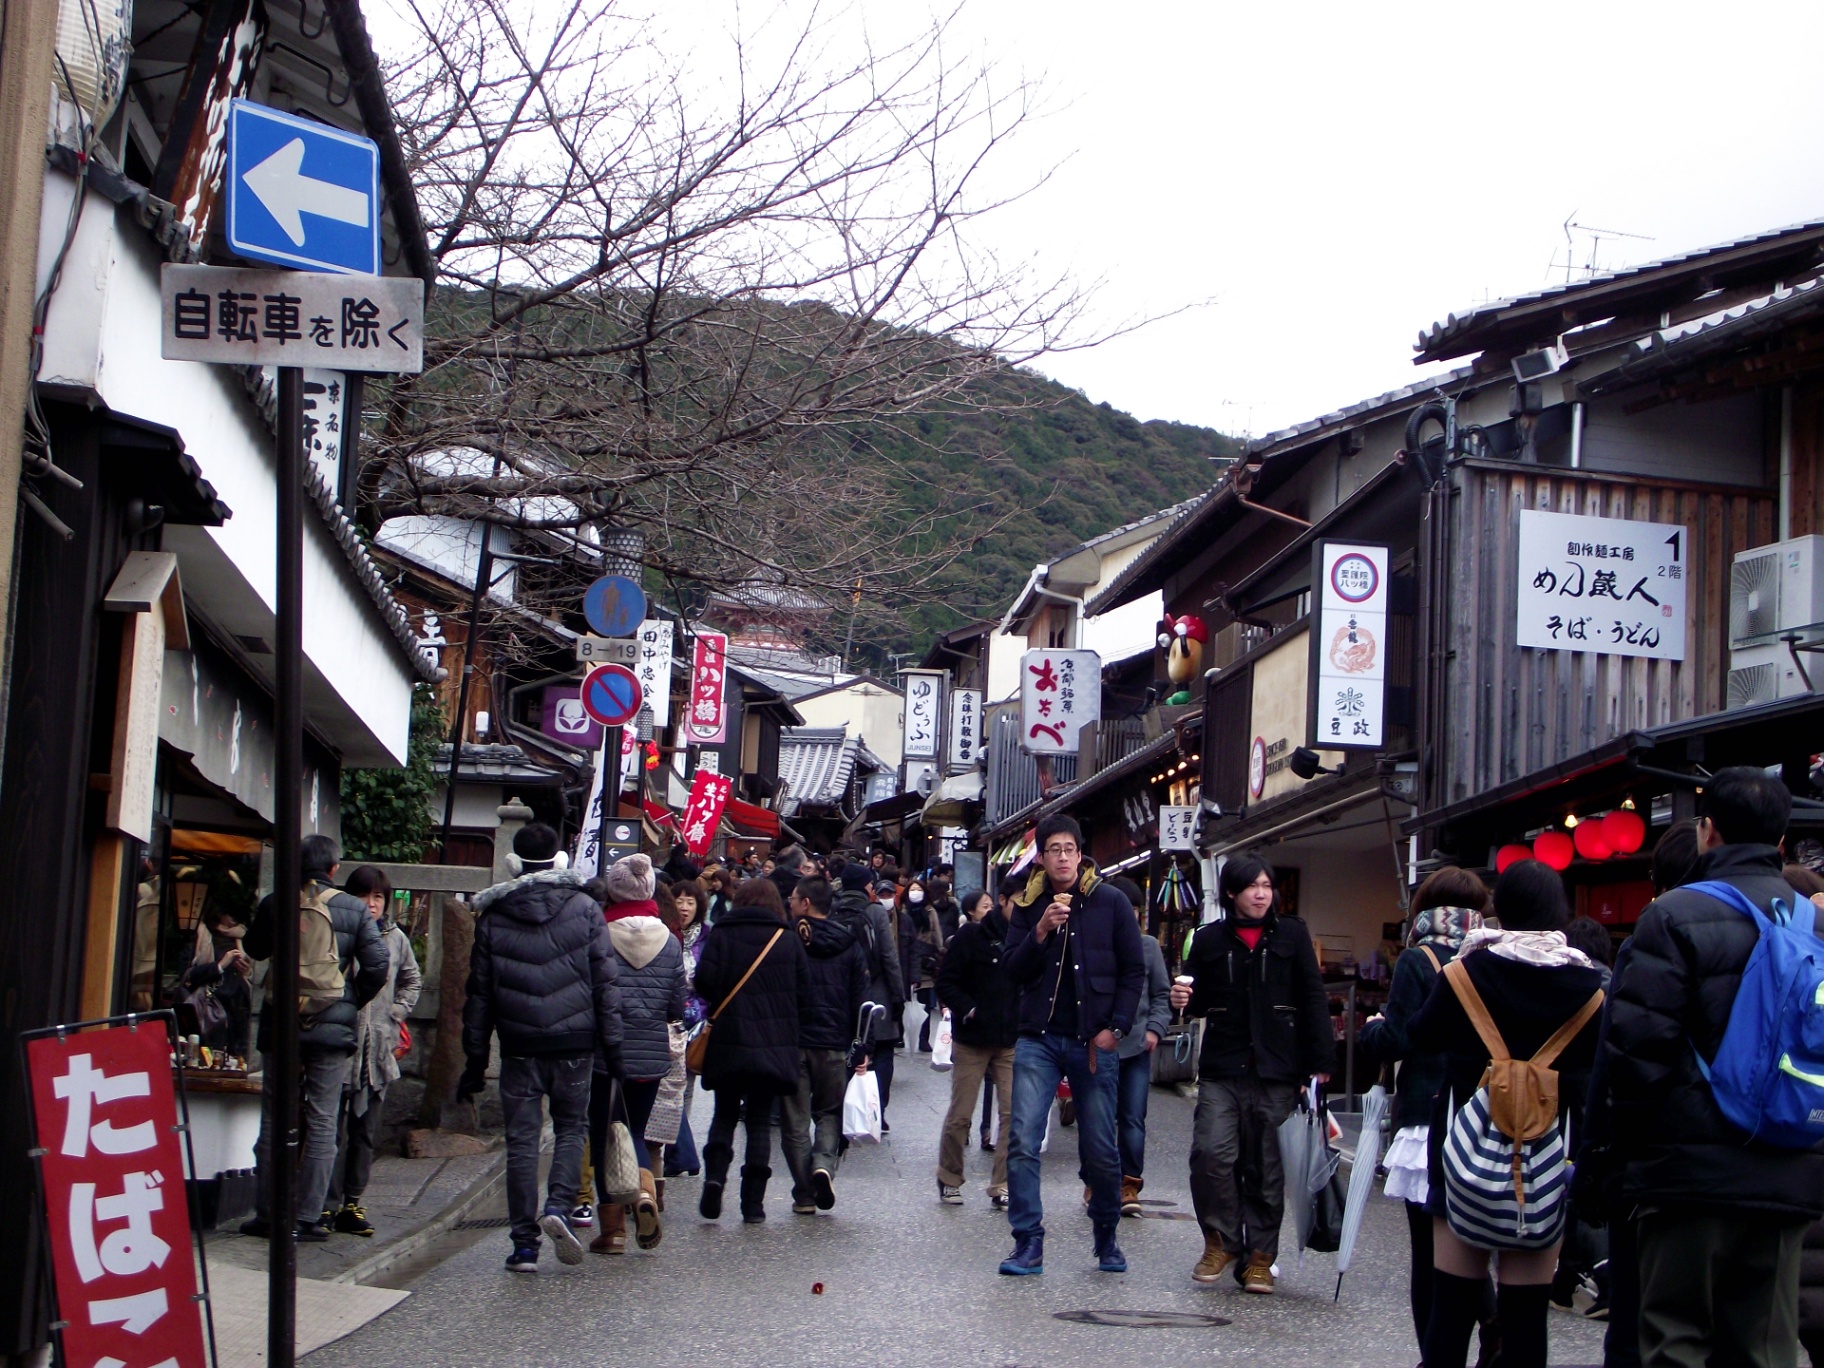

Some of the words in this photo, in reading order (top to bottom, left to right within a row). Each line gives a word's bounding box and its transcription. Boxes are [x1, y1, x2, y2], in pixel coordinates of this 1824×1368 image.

[174, 287, 410, 351] 自転車を除く
[325, 379, 340, 461] 京名物
[1533, 561, 1660, 607] めん蔵人
[910, 681, 932, 742] ゆどうふ
[1028, 658, 1067, 748] おたべ
